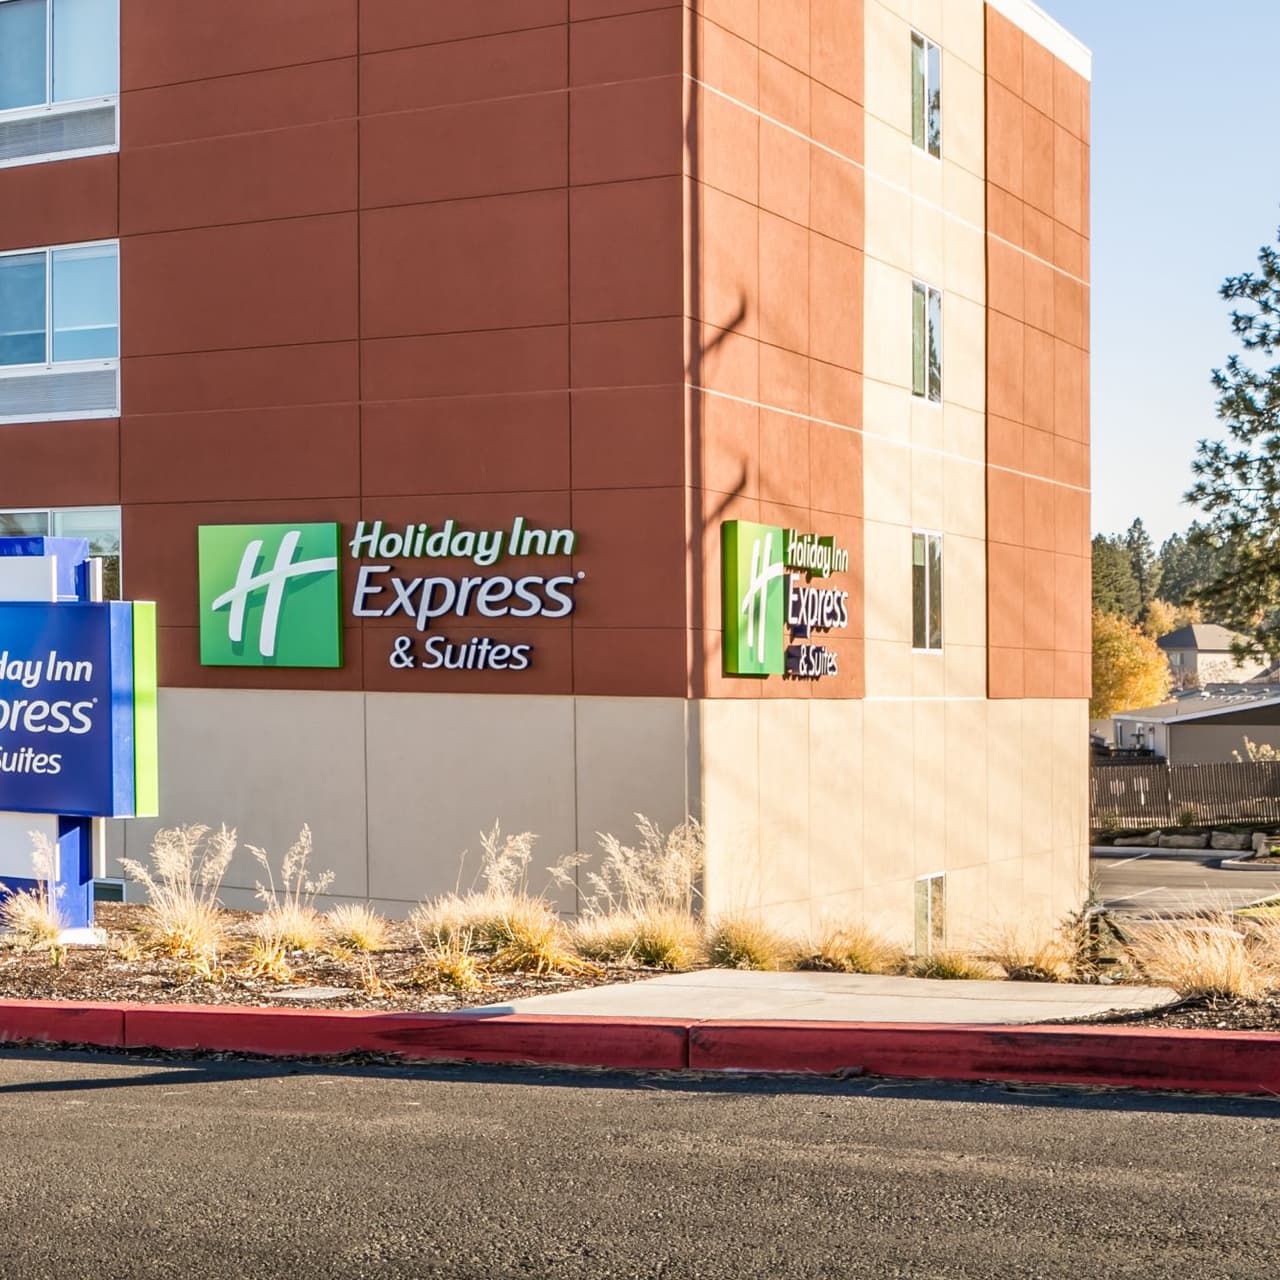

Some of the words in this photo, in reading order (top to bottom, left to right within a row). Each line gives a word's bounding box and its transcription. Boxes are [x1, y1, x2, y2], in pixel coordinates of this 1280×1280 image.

[349, 519, 503, 566] Holiday
[507, 516, 575, 556] Inn
[788, 529, 831, 578] Holiday
[832, 535, 849, 572] Inn
[352, 565, 574, 632] Express
[788, 573, 848, 638] Express
[46, 650, 93, 682] Inn
[389, 636, 415, 669] &
[422, 636, 531, 670] Suites
[798, 644, 808, 676] &
[808, 644, 838, 676] Suites
